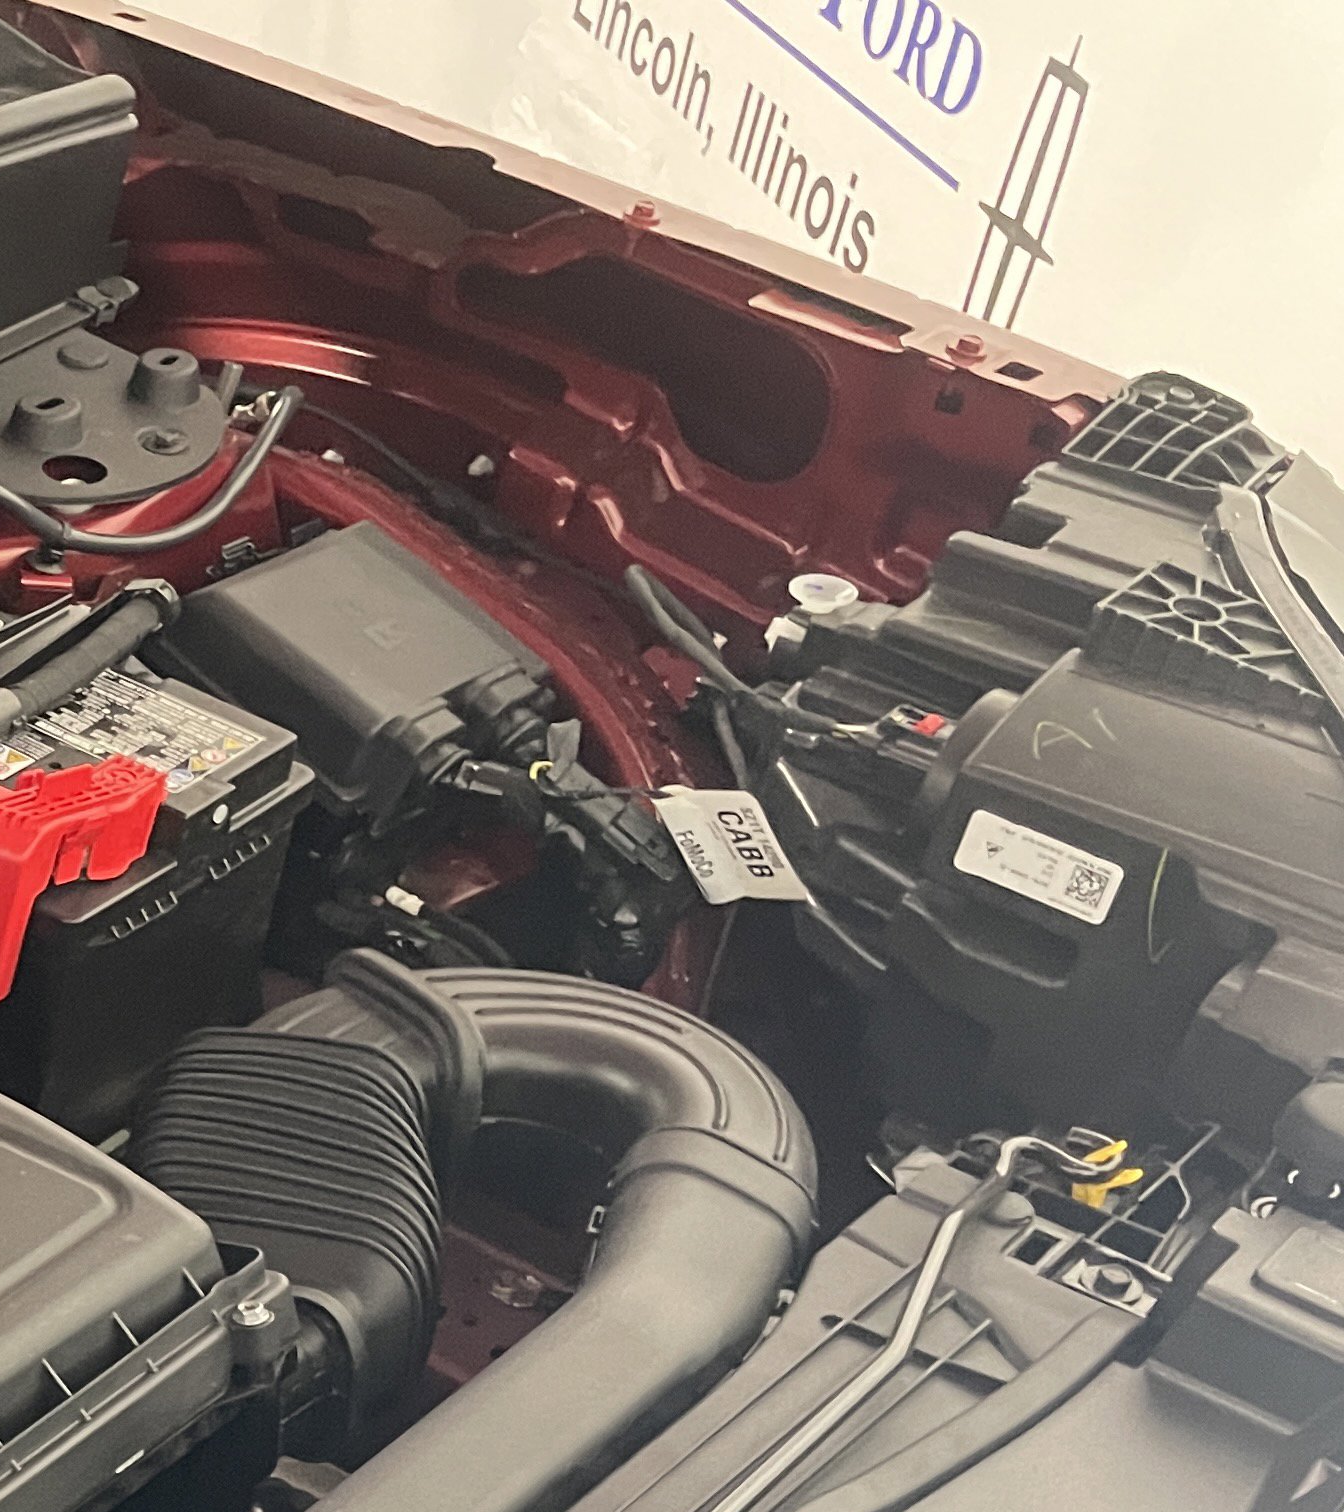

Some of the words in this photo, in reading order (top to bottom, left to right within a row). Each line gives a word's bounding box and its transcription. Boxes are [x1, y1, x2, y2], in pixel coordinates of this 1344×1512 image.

[728, 82, 875, 274] Illinois
[675, 830, 714, 878] FoMoCo
[717, 811, 774, 877] CABB
